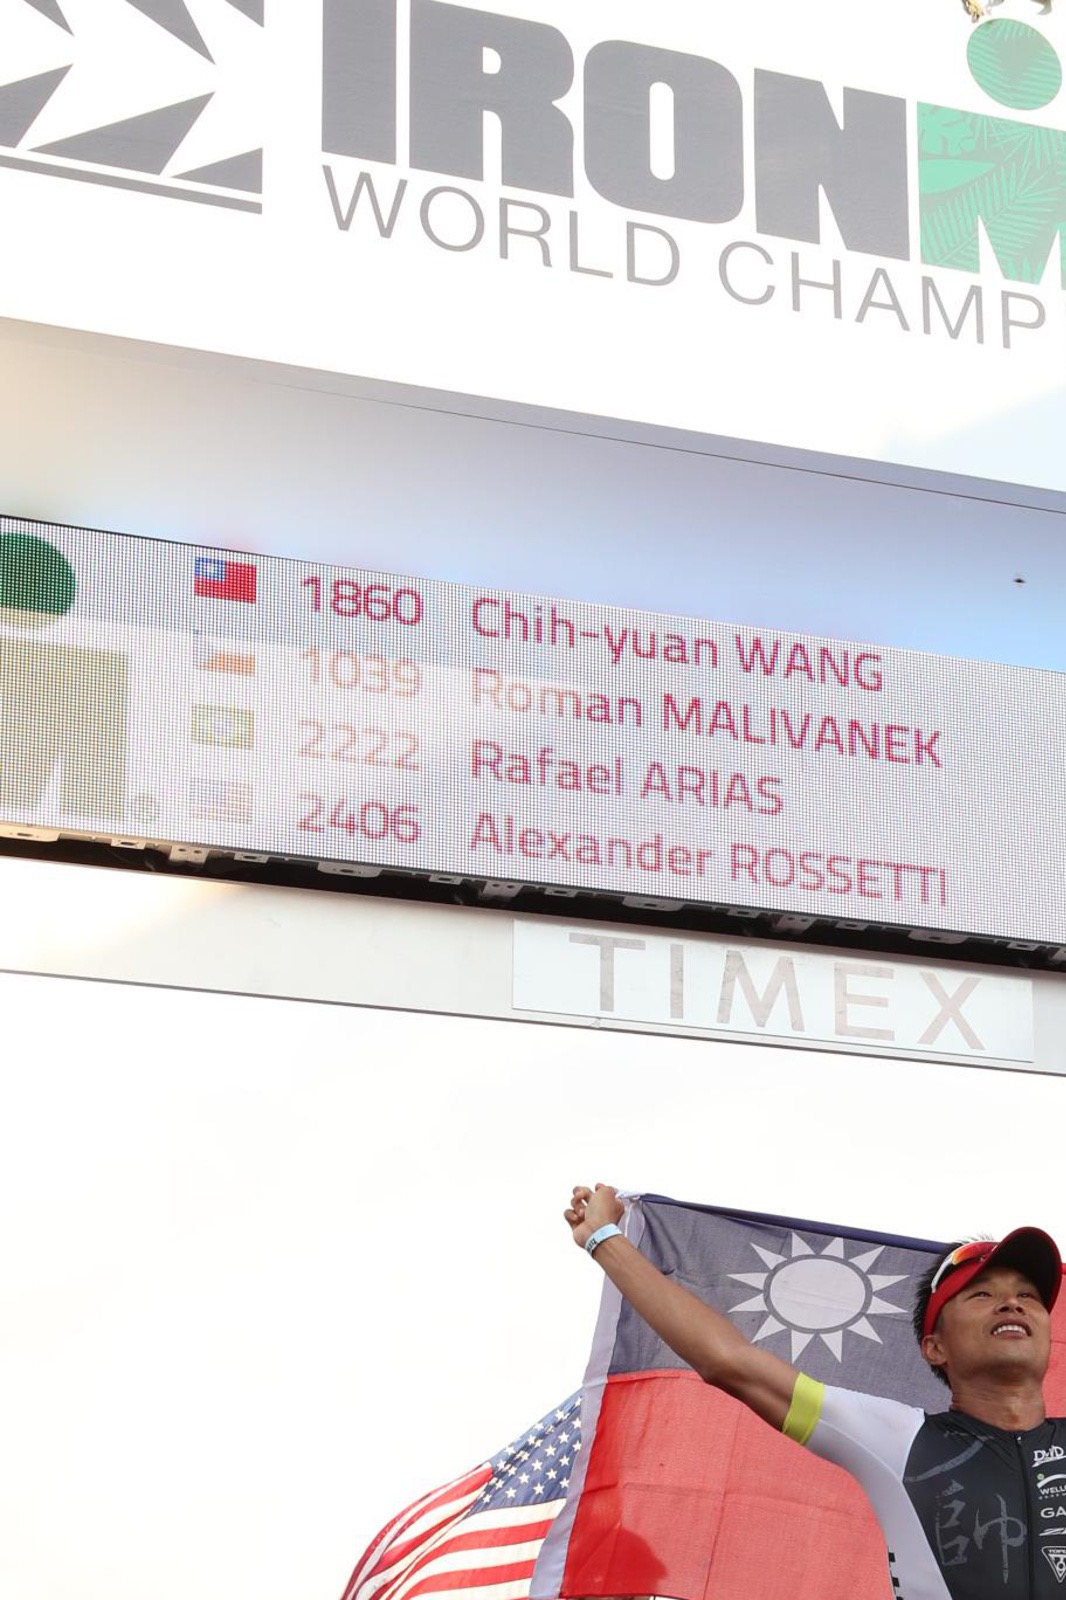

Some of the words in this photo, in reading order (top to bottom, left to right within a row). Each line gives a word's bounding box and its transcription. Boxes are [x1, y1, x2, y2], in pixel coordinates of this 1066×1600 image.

[321, 164, 681, 287] WORLD
[300, 576, 425, 626] 1860
[471, 597, 718, 668] Chih-yuan
[735, 633, 883, 693] WANG
[300, 645, 422, 698] 1039
[470, 667, 643, 728] Roman
[663, 693, 943, 768] MALIVANEK
[299, 718, 421, 772] 2222
[470, 739, 624, 796] Rafael
[640, 761, 784, 817] ARIAS
[298, 792, 421, 844] 2406
[470, 812, 712, 878] Alexander
[730, 843, 947, 906] ROSSETTI
[568, 931, 985, 1051] TIMEX
